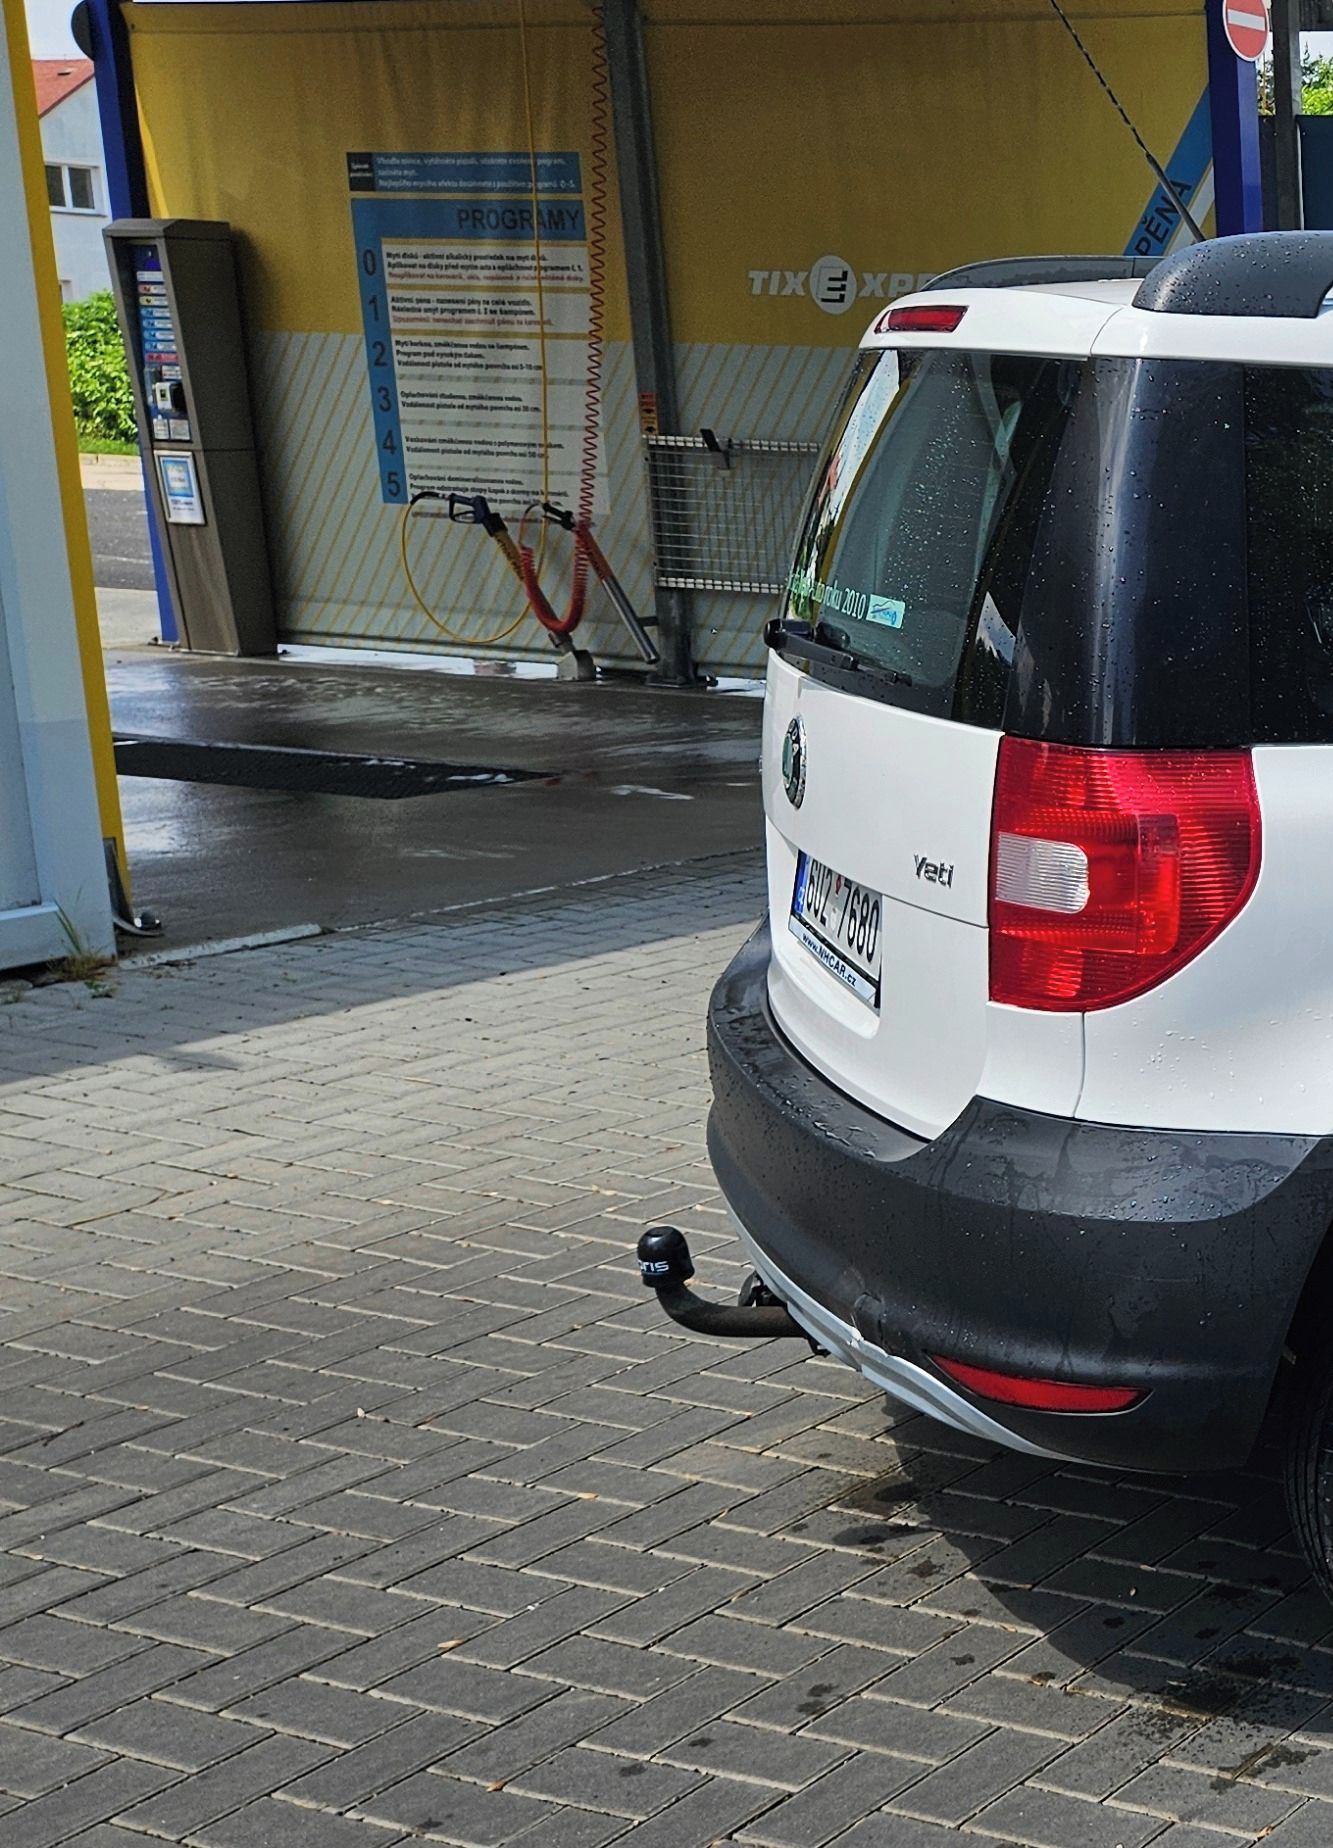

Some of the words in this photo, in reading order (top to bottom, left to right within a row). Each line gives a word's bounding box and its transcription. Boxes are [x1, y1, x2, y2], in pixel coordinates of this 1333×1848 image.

[458, 208, 579, 231] PROGRAMY
[363, 249, 376, 276] 0
[368, 295, 379, 321] 1
[372, 340, 388, 367] 2
[377, 385, 392, 413] 3
[382, 429, 396, 455] 4
[386, 472, 401, 498] 5
[841, 587, 867, 621] 2010
[914, 854, 955, 889] Yeti
[807, 858, 833, 927] 6U2
[838, 877, 880, 964] 7680
[803, 933, 858, 988] www.NHCAR.cz
